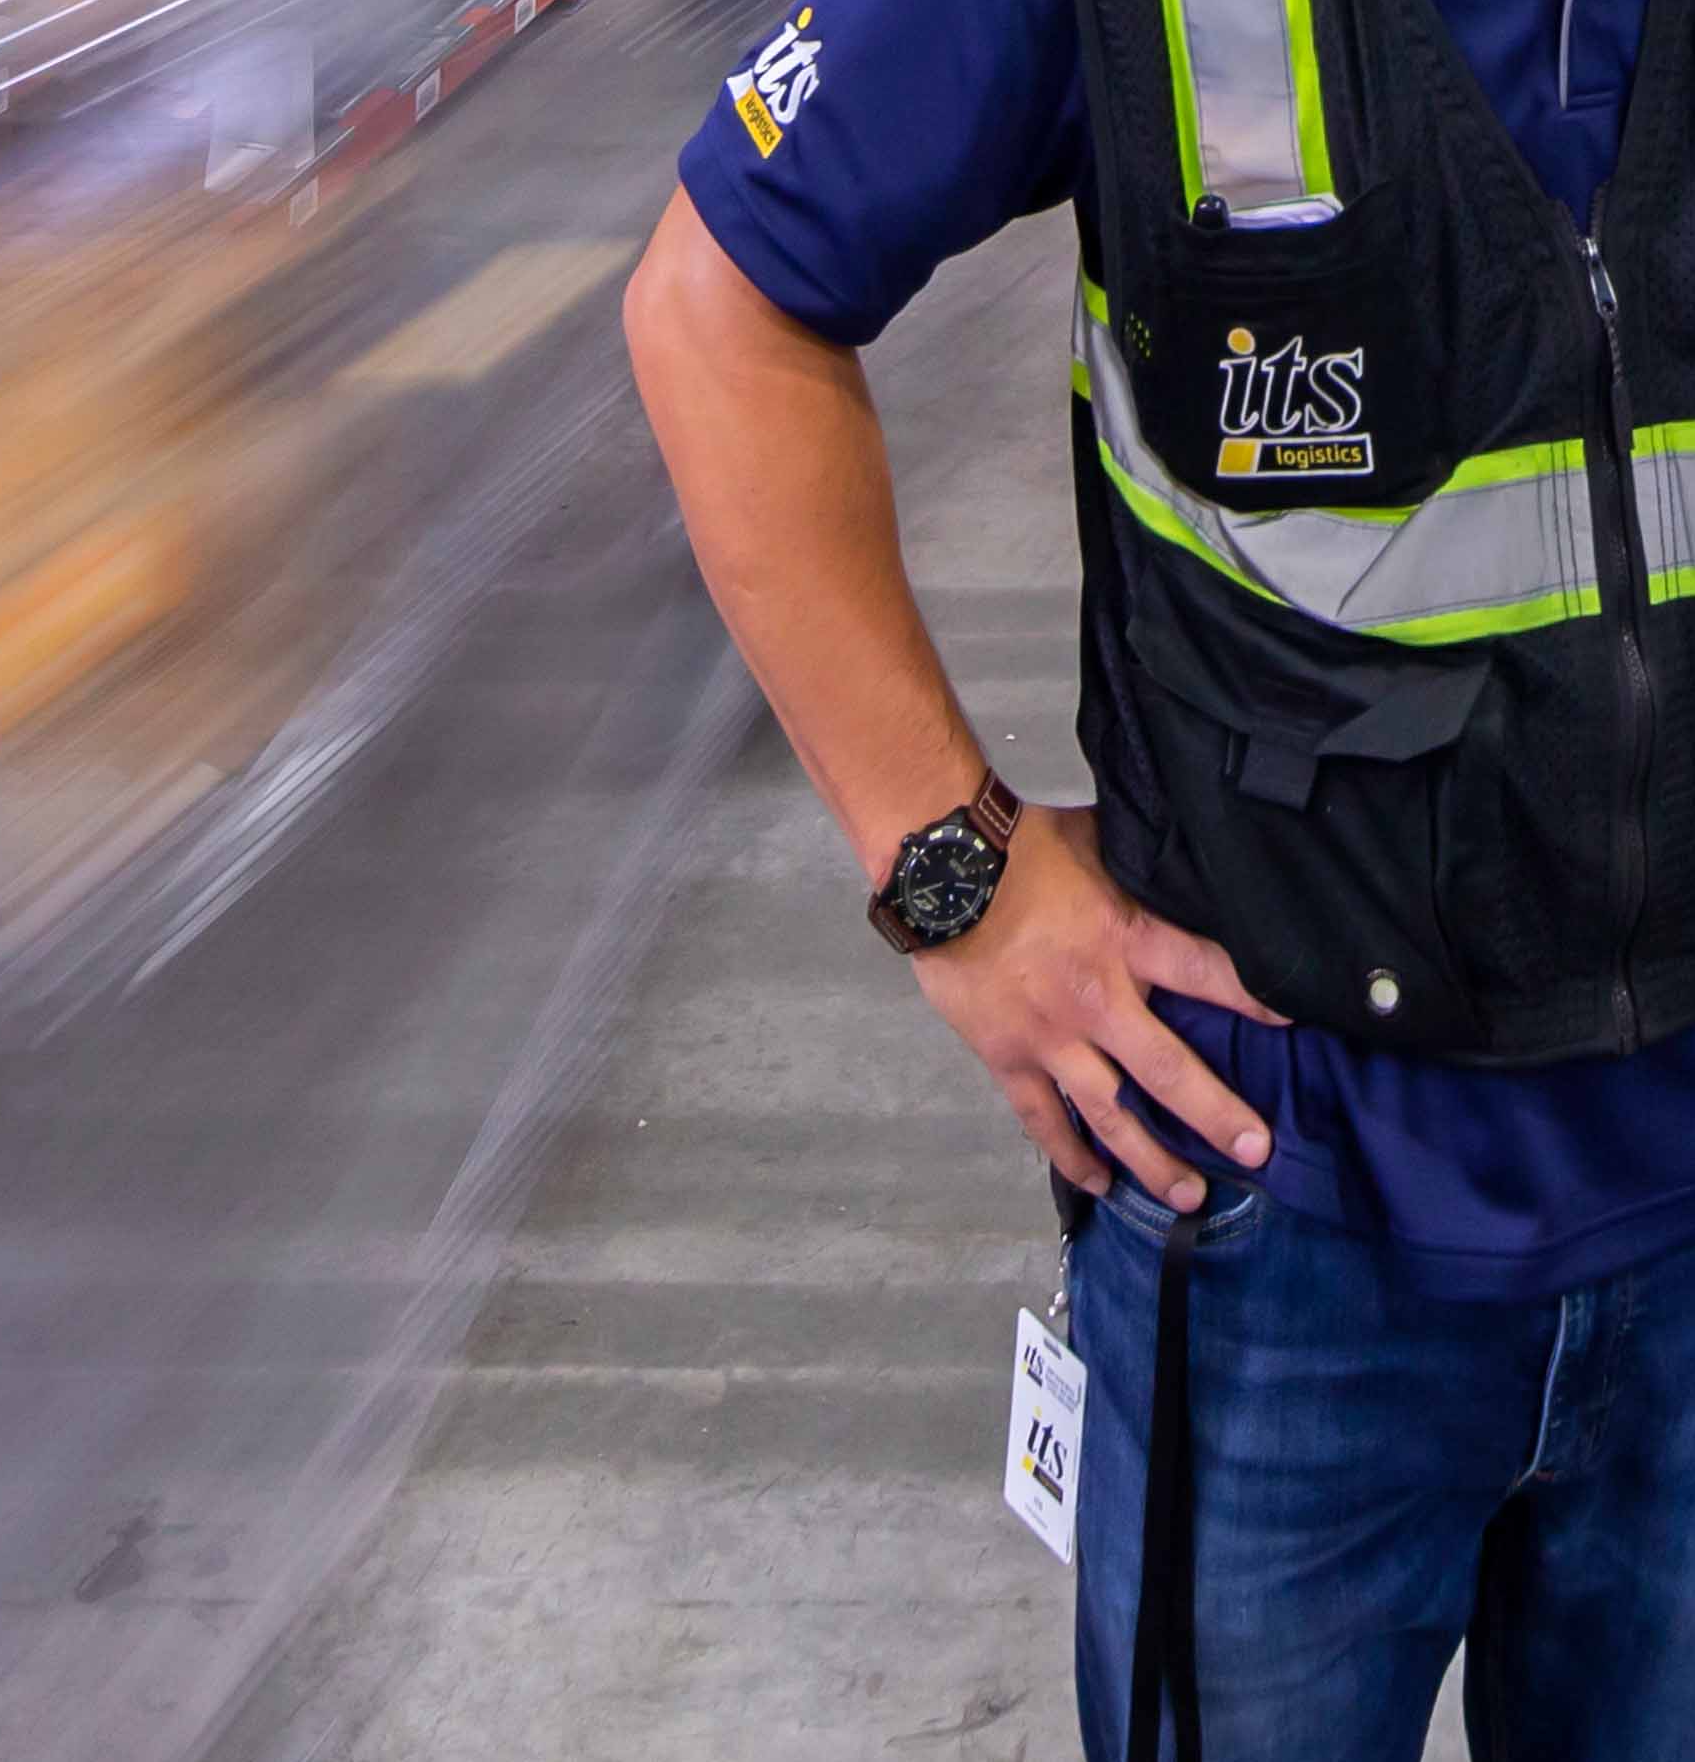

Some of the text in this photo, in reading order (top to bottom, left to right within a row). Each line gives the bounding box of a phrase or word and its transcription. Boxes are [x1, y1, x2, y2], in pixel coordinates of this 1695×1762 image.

[753, 6, 823, 125] its
[1219, 327, 1364, 435] its
[1276, 444, 1363, 469] logistics
[1027, 1405, 1069, 1480] its
